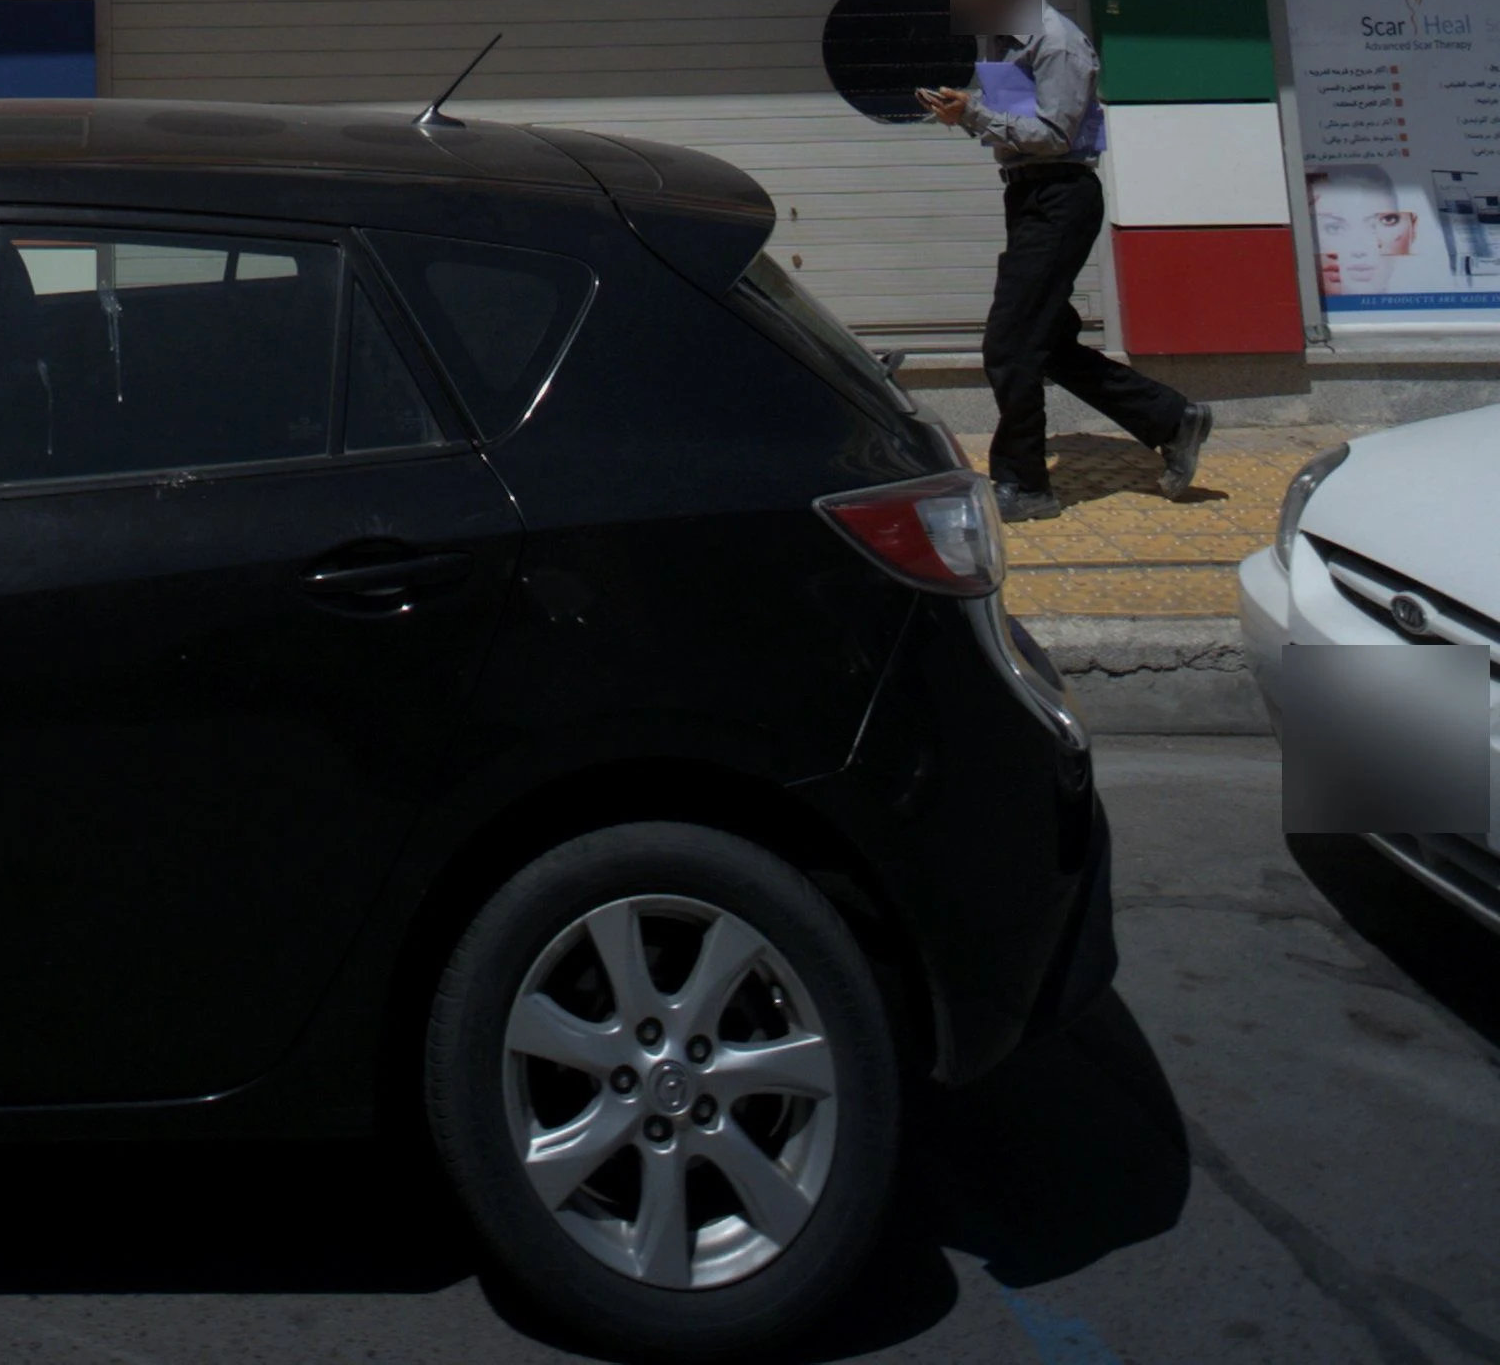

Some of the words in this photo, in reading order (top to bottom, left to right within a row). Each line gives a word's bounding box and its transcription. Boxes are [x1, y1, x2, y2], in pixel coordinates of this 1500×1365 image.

[1361, 15, 1406, 38] Scar
[1423, 14, 1473, 35] Heal
[1365, 41, 1411, 52] Advanced
[1412, 40, 1433, 51] Scar
[1434, 39, 1473, 52] Therapy
[1379, 294, 1436, 306] PRODUCTS
